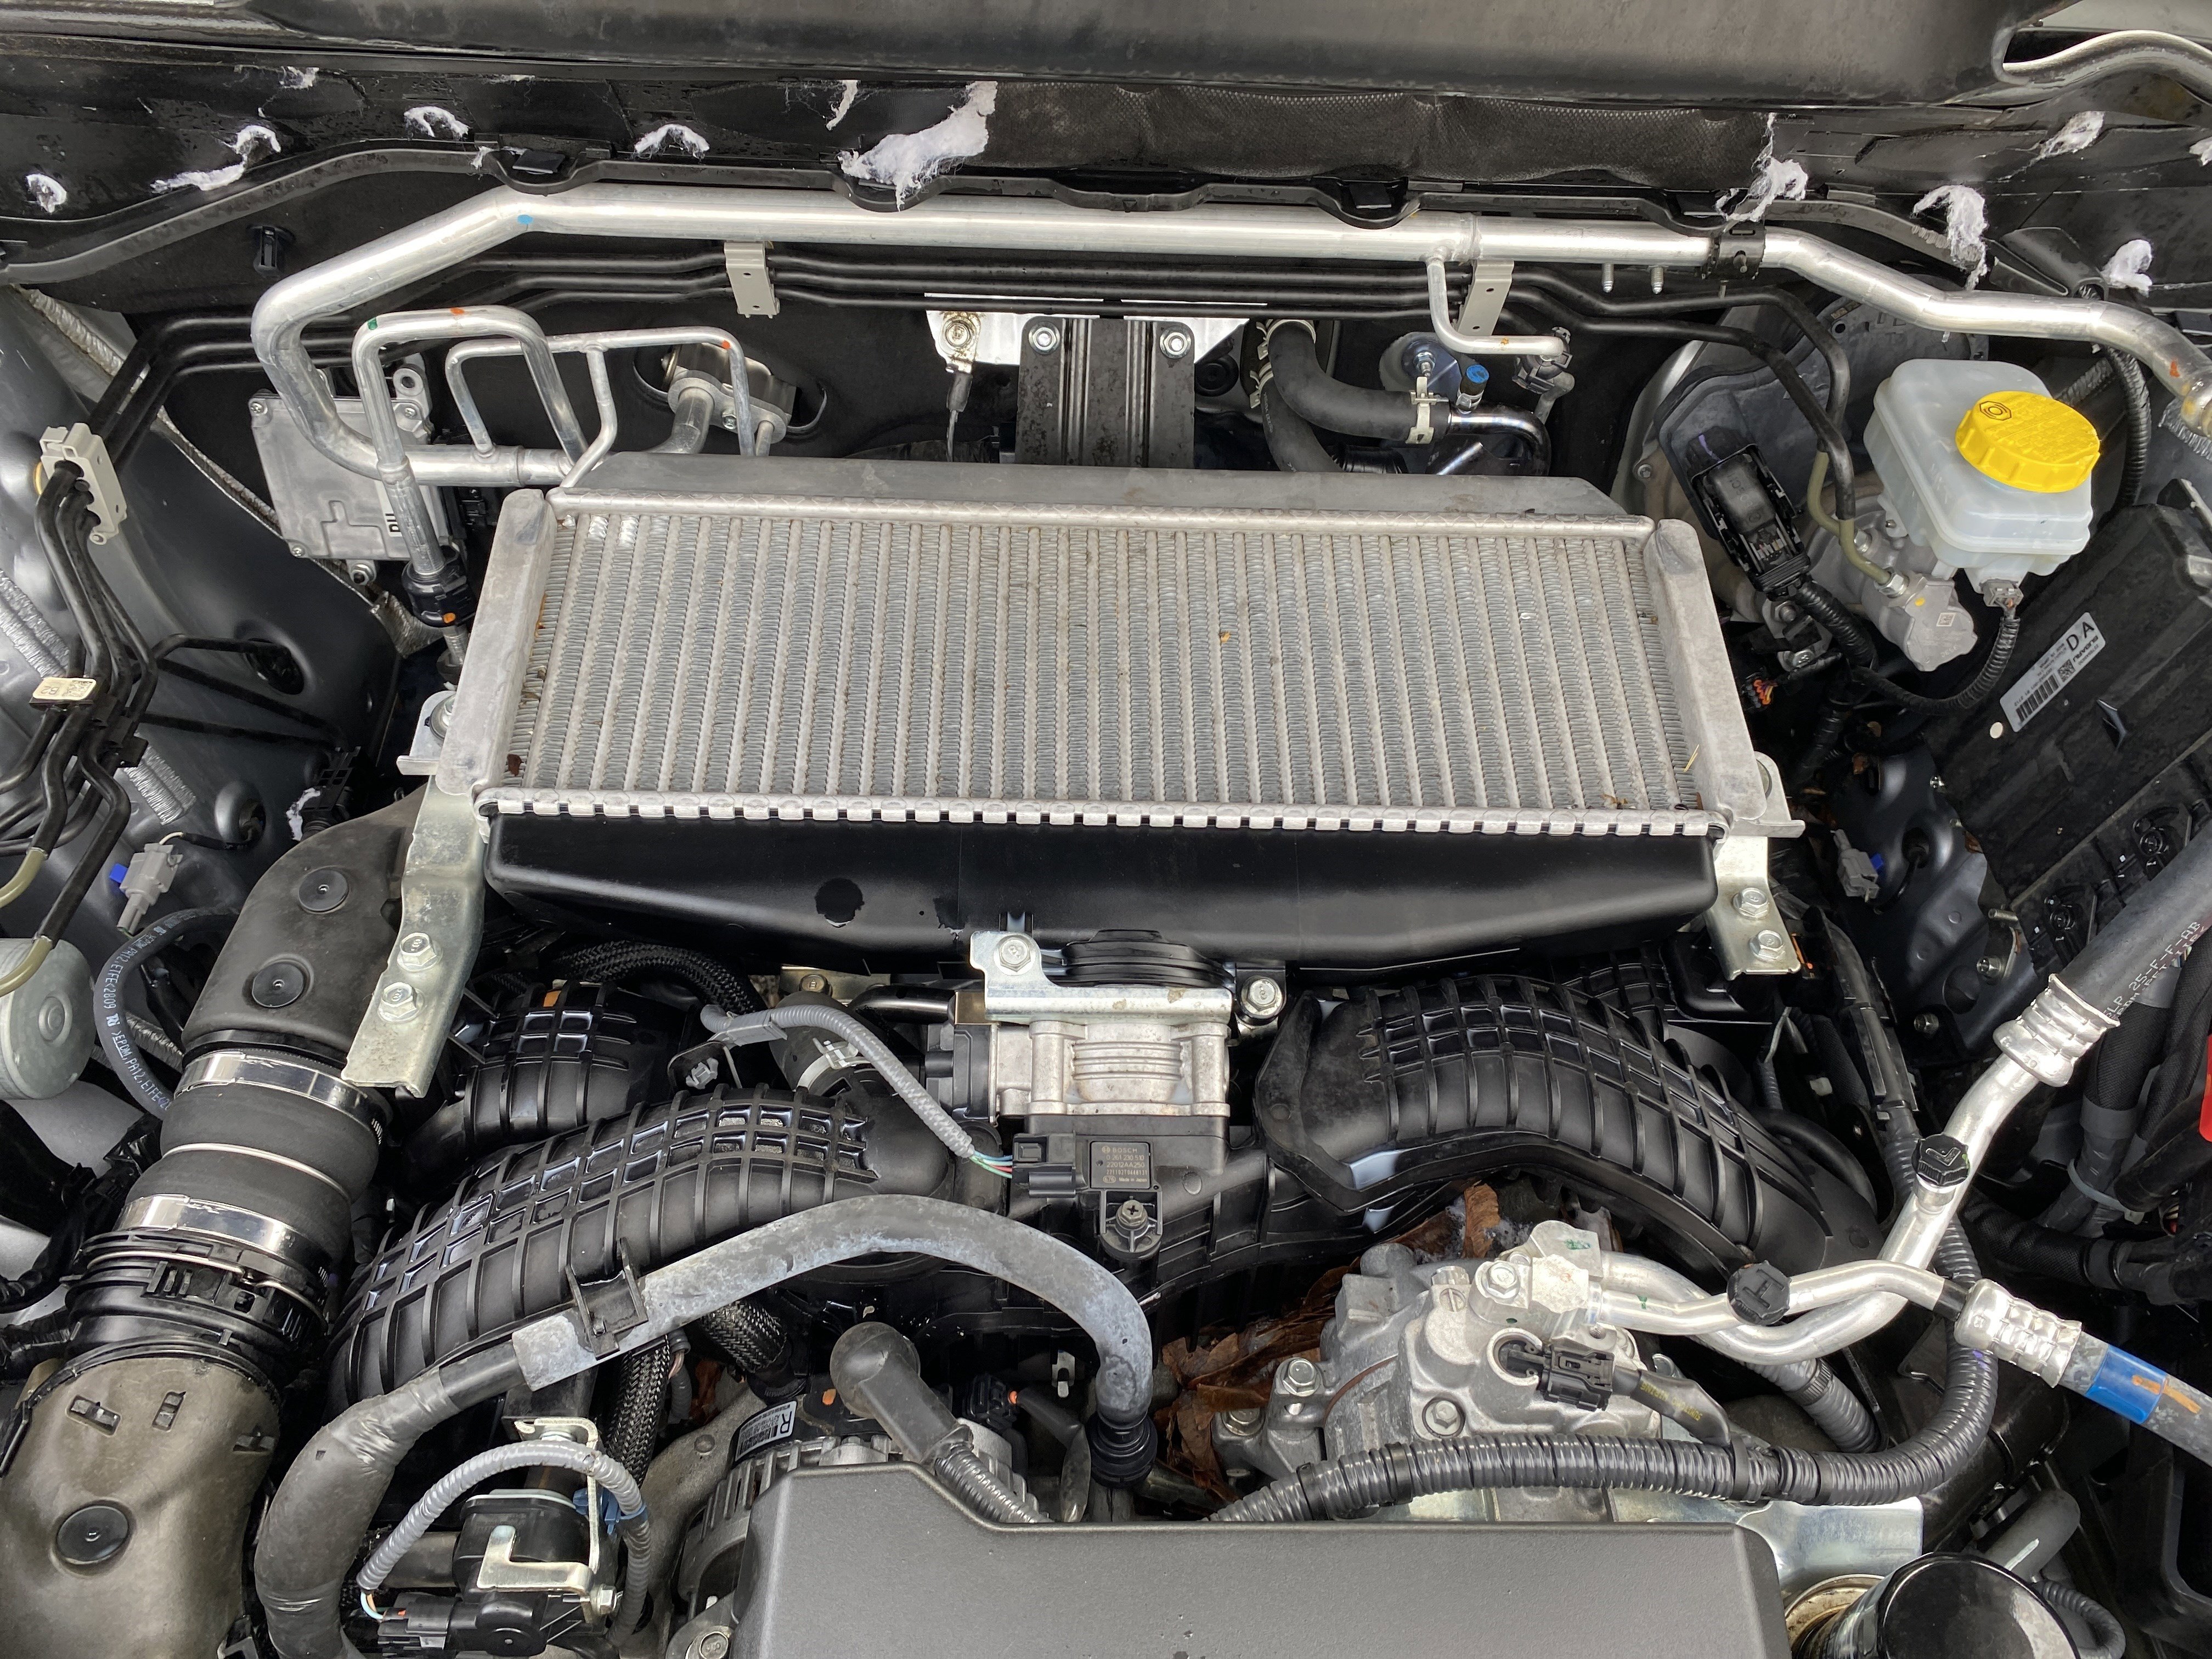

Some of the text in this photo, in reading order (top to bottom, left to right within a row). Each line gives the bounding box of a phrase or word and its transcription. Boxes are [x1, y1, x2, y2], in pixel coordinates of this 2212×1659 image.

[2073, 635, 2098, 662] SUBARU
[41, 686, 59, 695] B2
[1742, 1268, 1785, 1309] H
[780, 1410, 793, 1434] R
